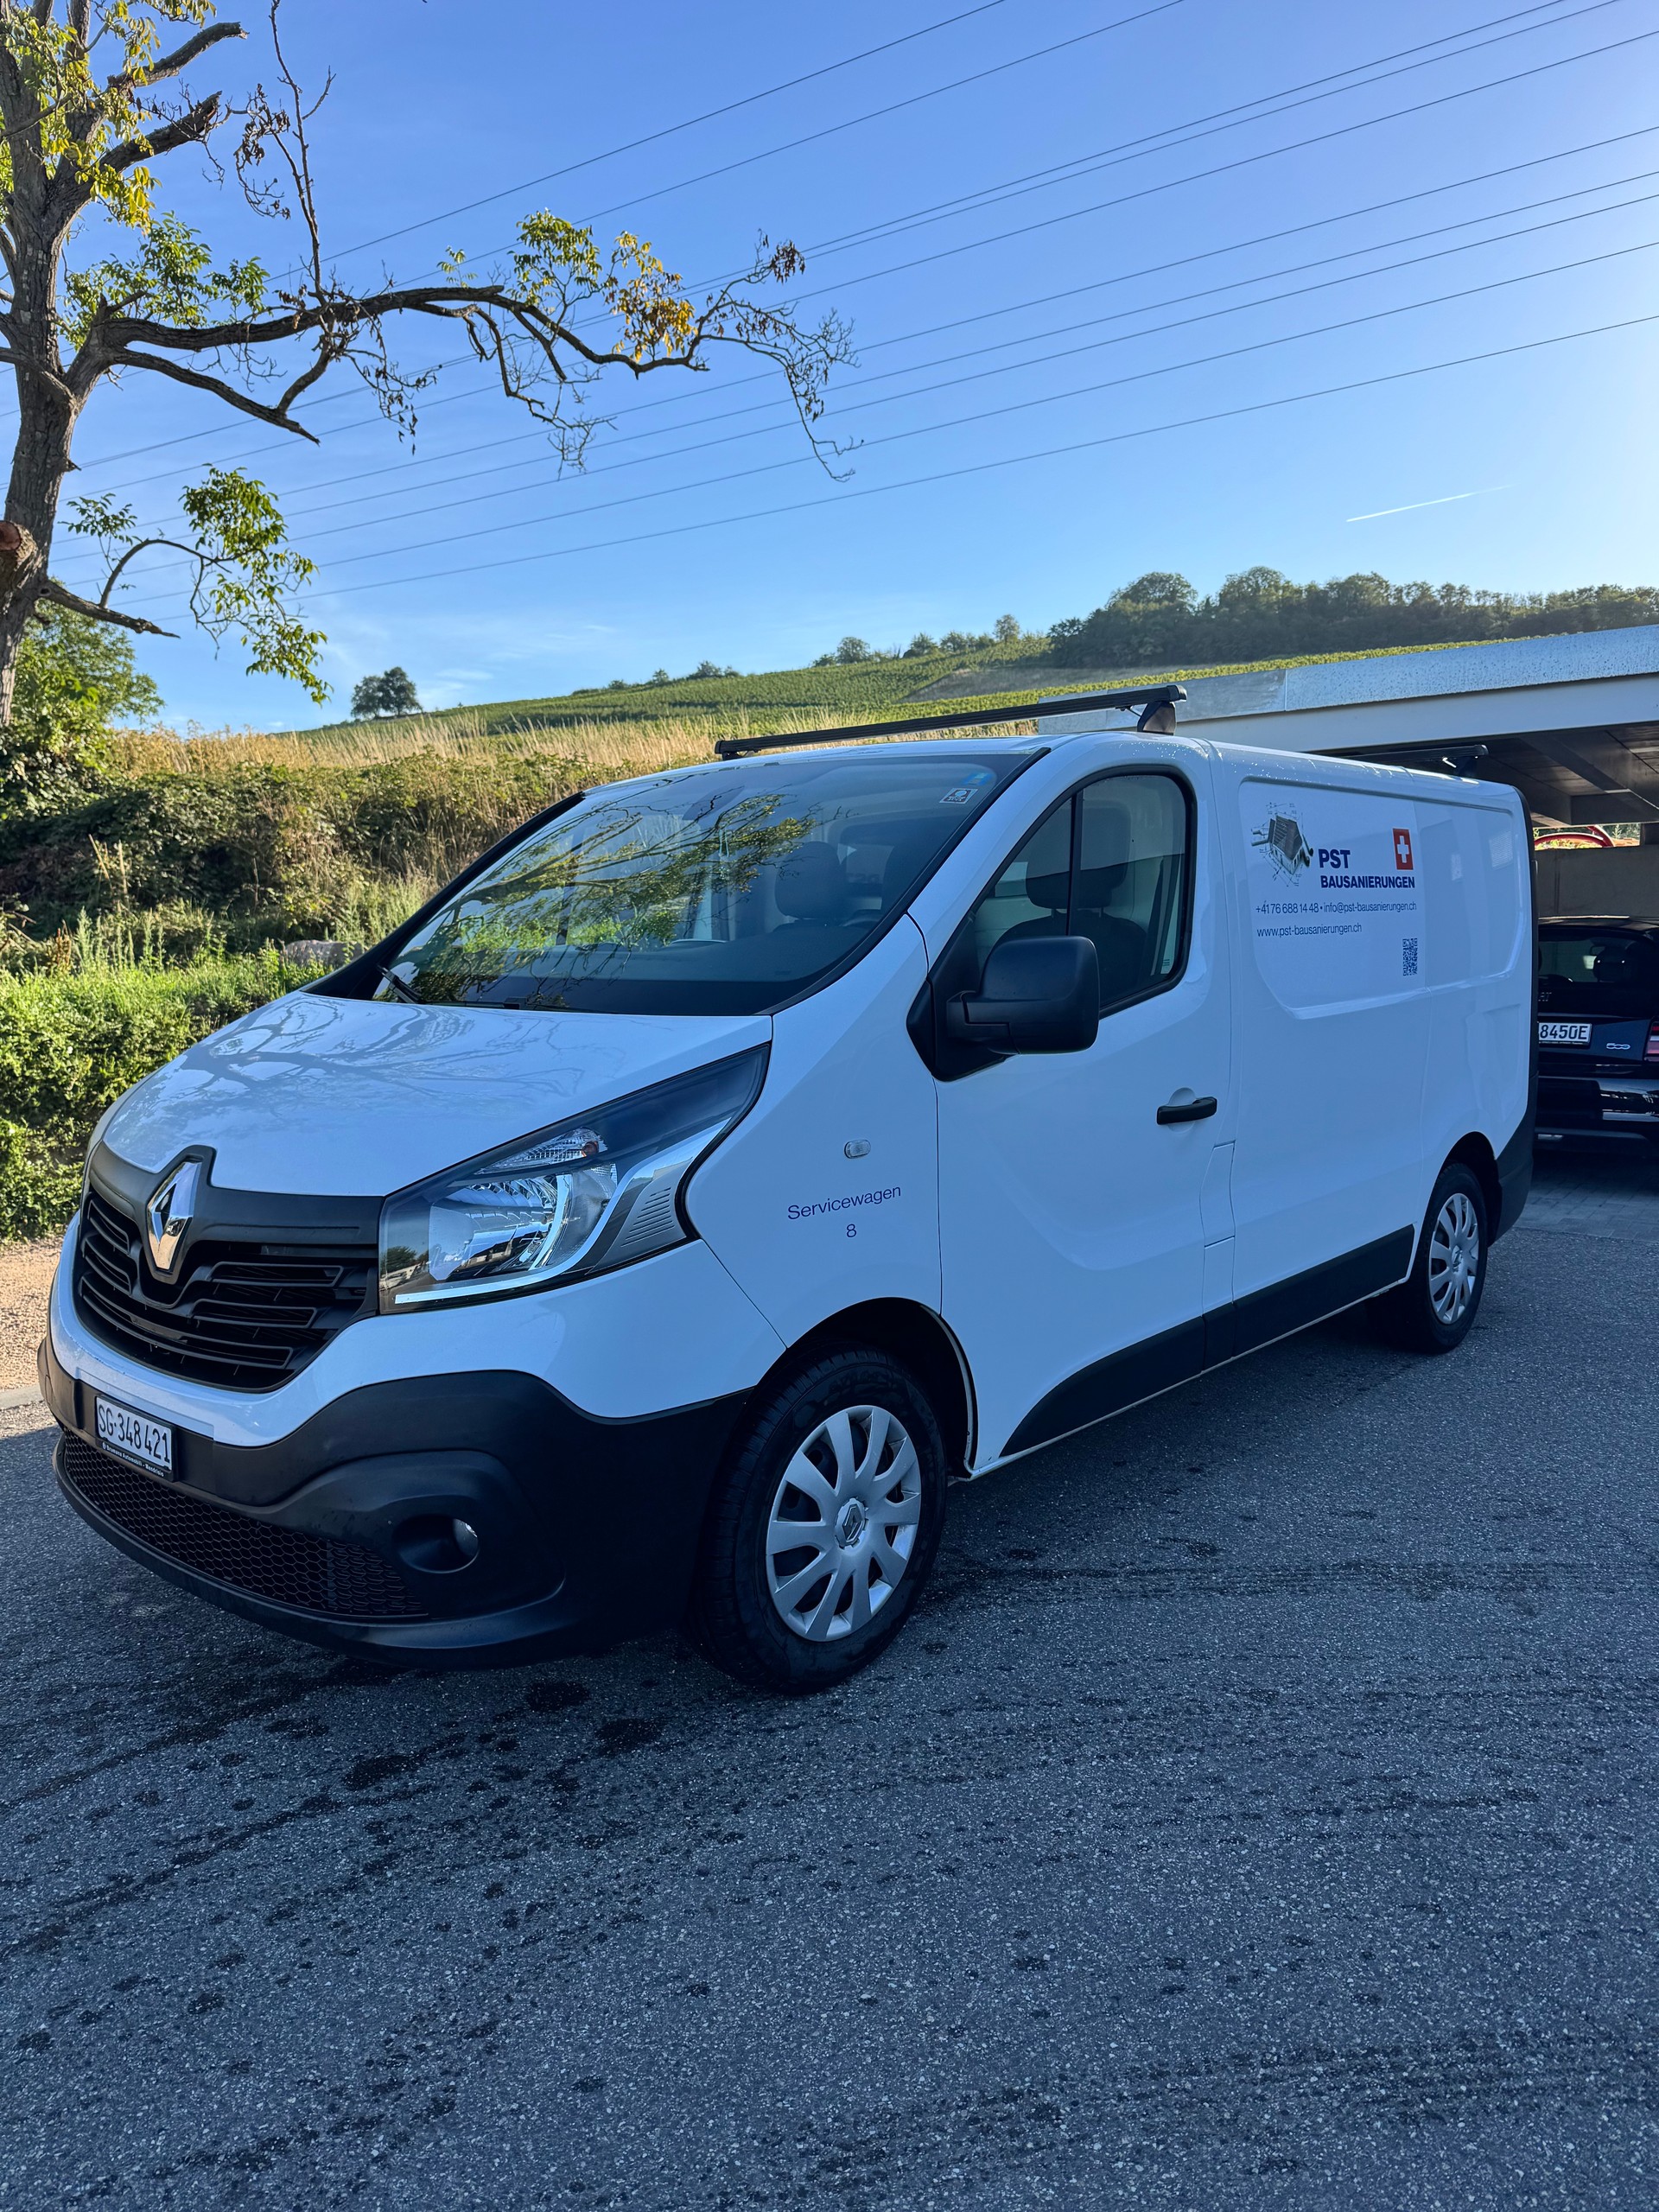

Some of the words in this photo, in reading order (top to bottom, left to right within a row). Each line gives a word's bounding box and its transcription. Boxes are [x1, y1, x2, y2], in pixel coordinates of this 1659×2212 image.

[1318, 849, 1351, 868] PST
[1320, 875, 1415, 888] BAUSANIERUNGEN
[1282, 903, 1298, 913] 688
[1300, 903, 1308, 912] 14
[1309, 902, 1319, 912] 48
[1324, 901, 1417, 913] info@pst-bausanierungen.ch
[1257, 922, 1363, 938] www.pst-bausanierungen.ch
[787, 1186, 901, 1219] Servicewagen
[846, 1224, 857, 1237] 8
